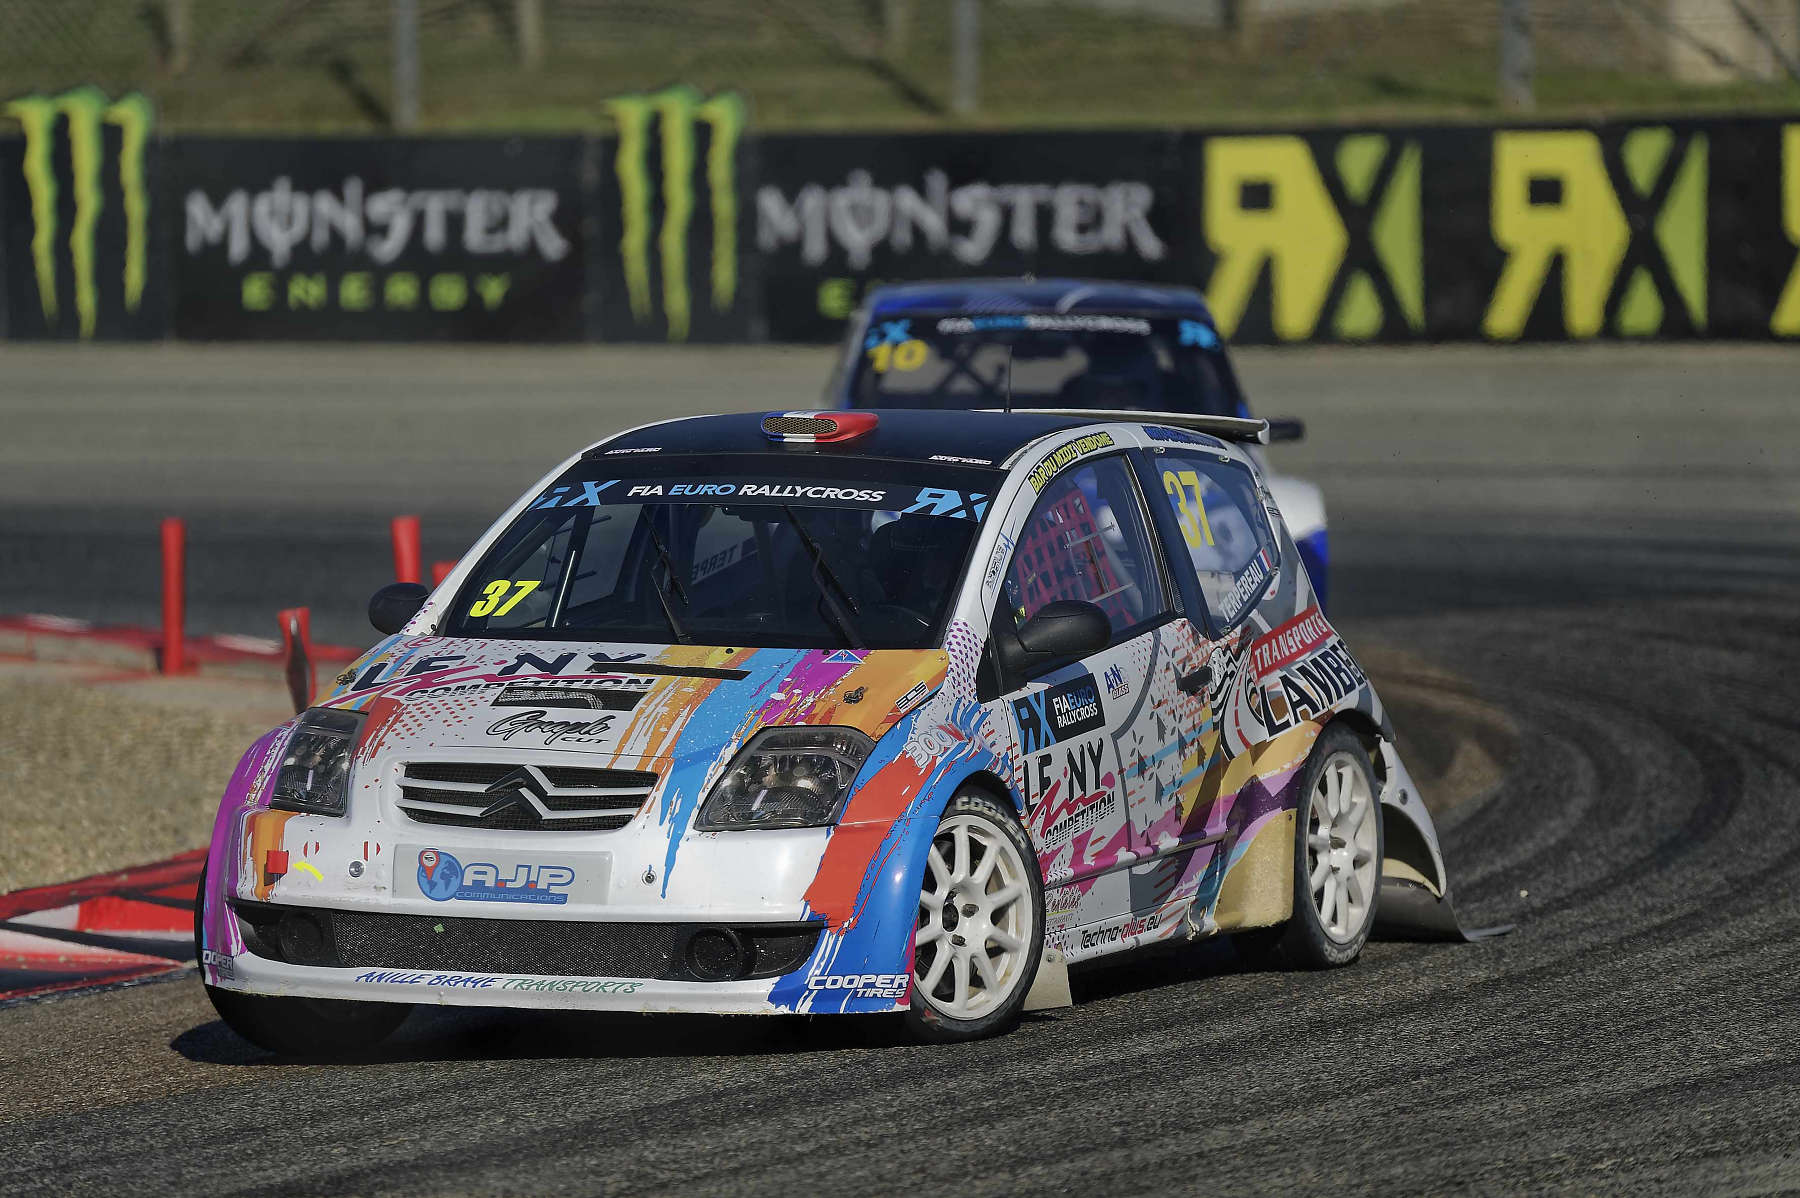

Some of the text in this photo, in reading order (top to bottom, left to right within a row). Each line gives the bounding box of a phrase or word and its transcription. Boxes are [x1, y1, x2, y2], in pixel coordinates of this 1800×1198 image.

[186, 175, 570, 267] MONSTER
[756, 168, 1166, 270] MONSTER
[241, 272, 511, 312] ENERGY
[866, 338, 928, 373] 10
[1028, 464, 1049, 494] BAR
[1045, 456, 1060, 478] DU
[1055, 445, 1078, 469] MIDI
[1075, 432, 1114, 456] VENDOME
[626, 484, 887, 503] FIA EURO RALLYCROSS
[1162, 470, 1216, 549] 37
[469, 579, 542, 618] 37
[1218, 559, 1264, 623] TERPEREAU
[1254, 612, 1327, 674] TRANSPORTS
[1057, 702, 1099, 729] RALLYCROSS
[1066, 737, 1105, 802] NY
[1044, 790, 1116, 849] COMPETITION
[354, 971, 644, 994] ANILLE BRAYE TRANSPORTS
[807, 974, 910, 989] COOPER
[856, 988, 907, 998] TIRES
